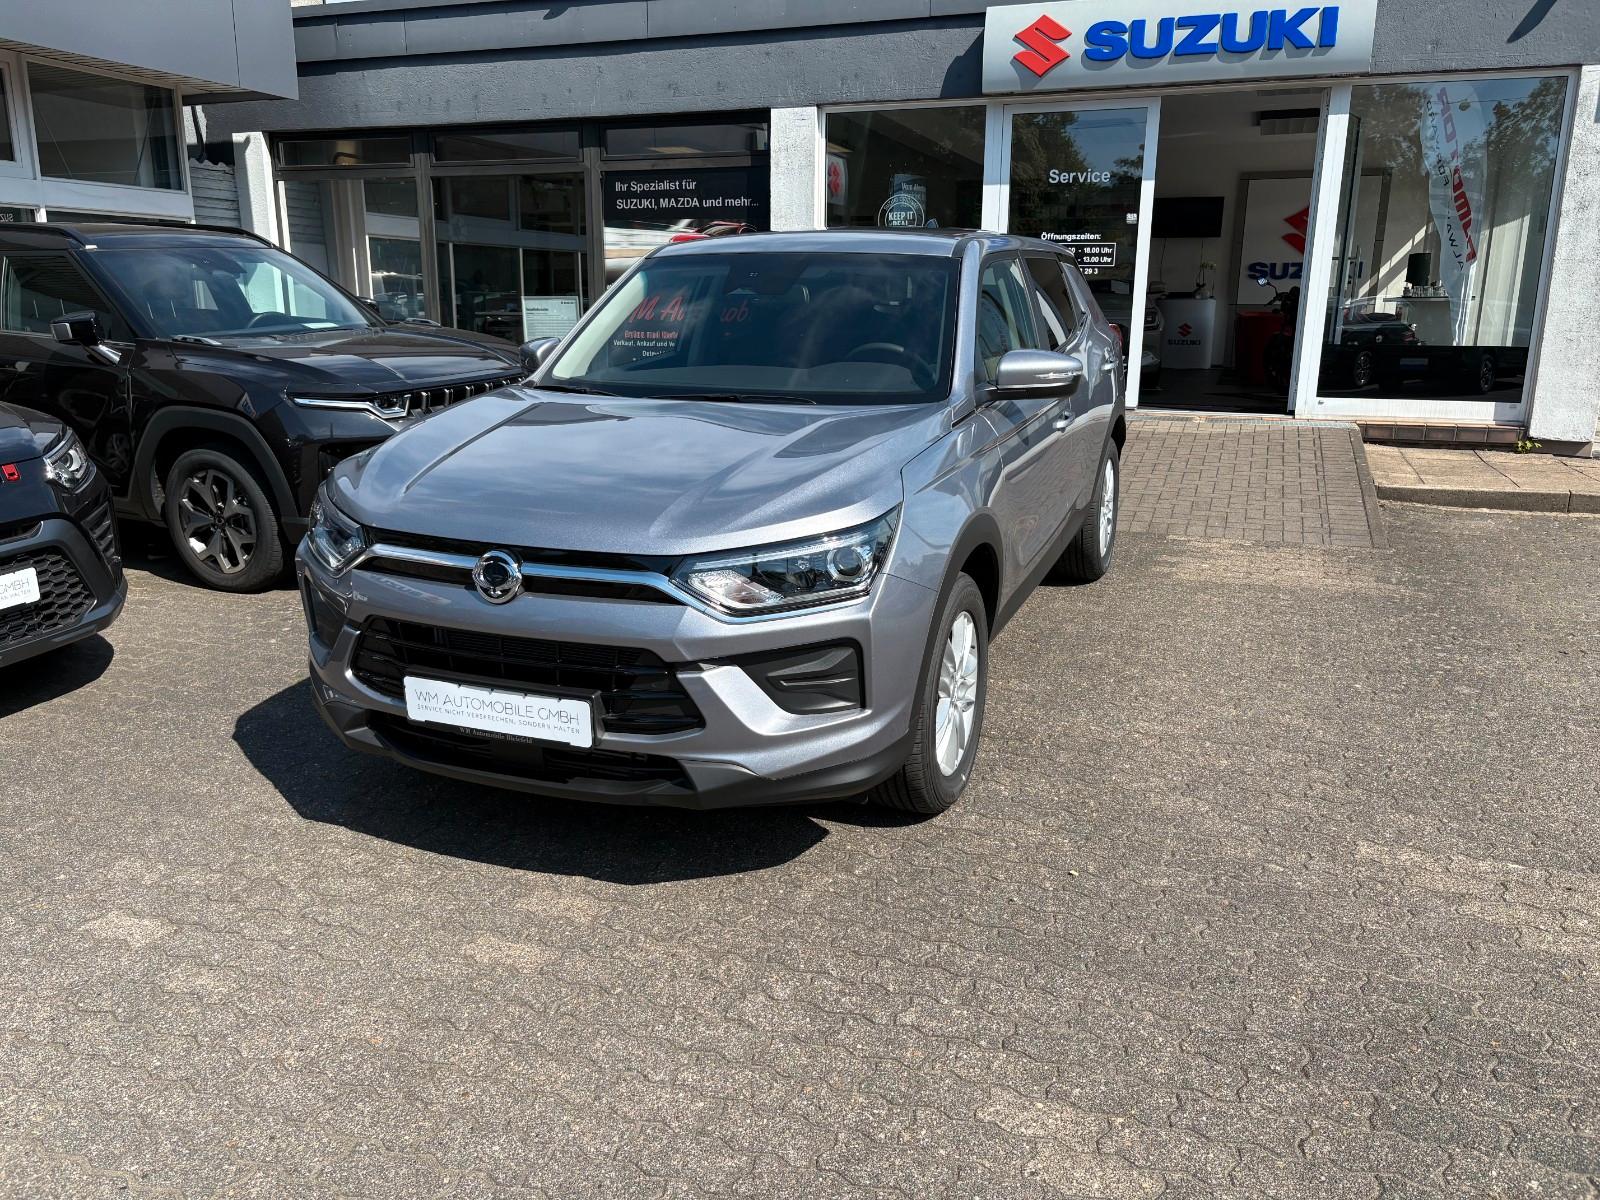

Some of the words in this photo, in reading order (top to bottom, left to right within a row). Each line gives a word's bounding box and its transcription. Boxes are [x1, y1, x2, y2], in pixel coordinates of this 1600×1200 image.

[1084, 6, 1340, 62] SUZUKI
[1048, 168, 1111, 184] Service
[615, 181, 627, 192] Ihr
[630, 180, 680, 194] Spezialist
[682, 179, 697, 190] für
[616, 198, 658, 211] SUZUKI,
[660, 197, 700, 209] MAZDA
[703, 196, 722, 208] und
[725, 196, 759, 207] mehr...
[888, 211, 906, 221] KEEP
[907, 211, 914, 220] IT
[1040, 231, 1102, 242] Öffnungszeiten:
[414, 688, 439, 705] WM
[442, 694, 535, 719] AUTOMOBILE
[537, 707, 580, 725] GMBH
[416, 703, 443, 714] SERVICE
[444, 708, 464, 716] NICHT
[518, 719, 551, 729] SONDERN
[553, 725, 580, 734] HALTEN
